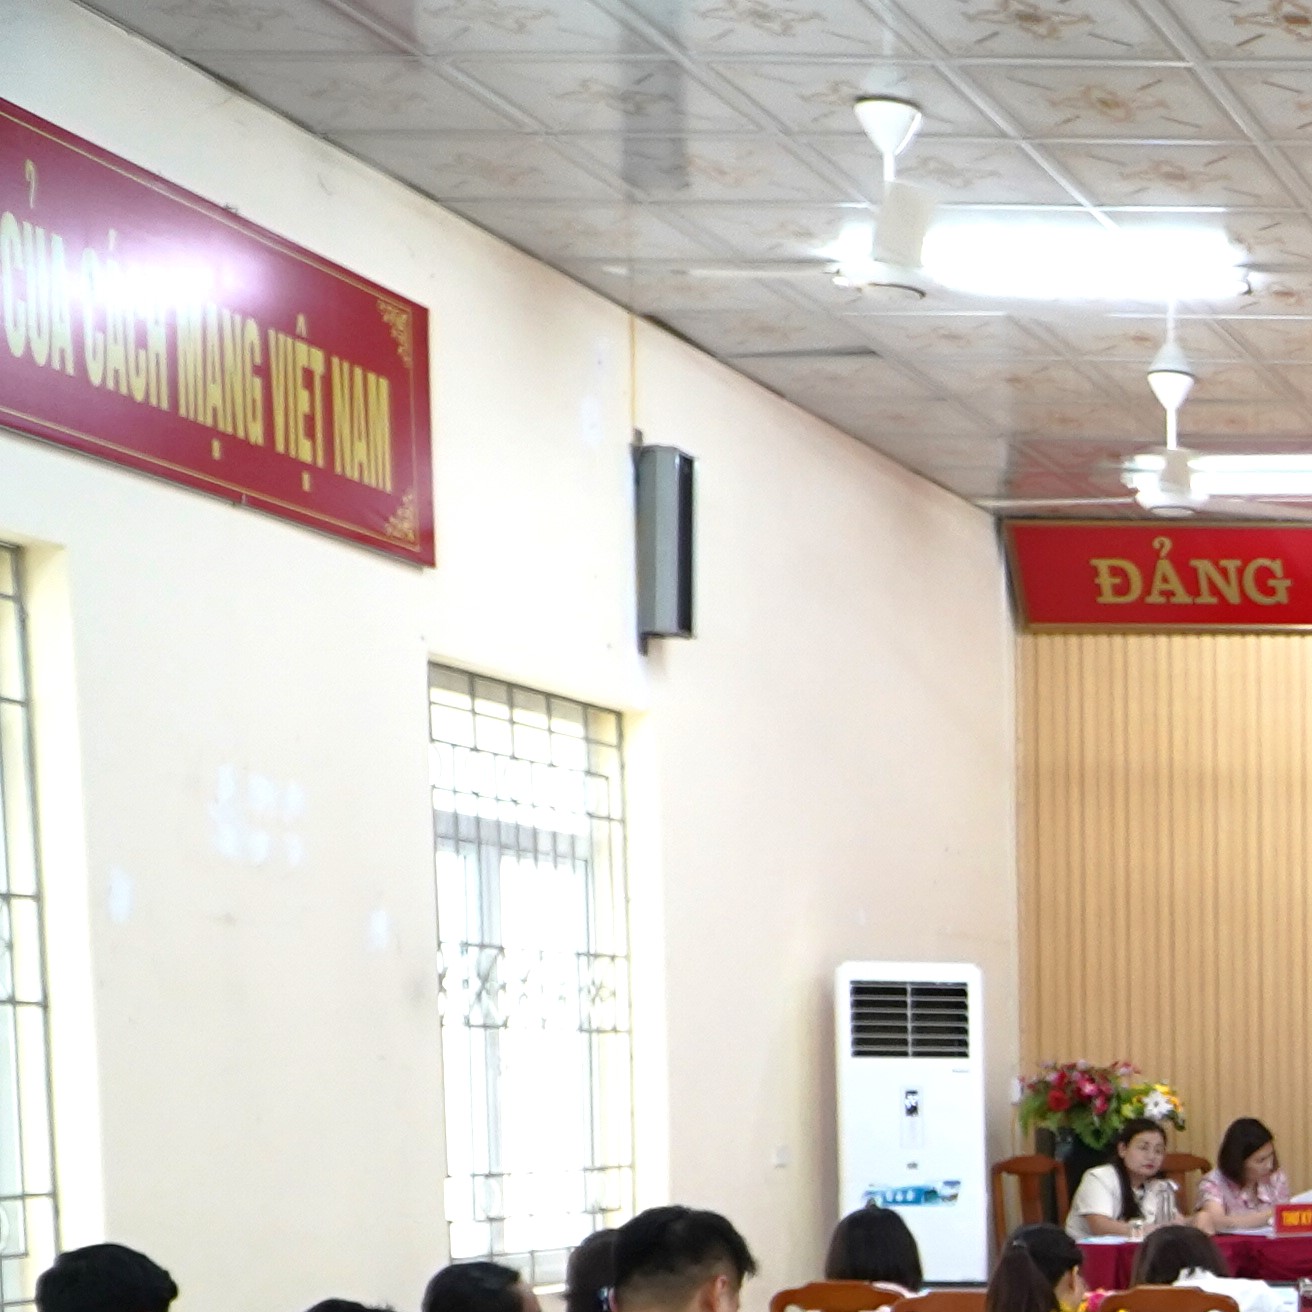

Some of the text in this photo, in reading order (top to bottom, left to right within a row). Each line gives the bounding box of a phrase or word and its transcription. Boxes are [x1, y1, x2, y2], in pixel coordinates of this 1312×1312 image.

[174, 294, 264, 461] MẠNG
[267, 313, 325, 492] VIỆT
[331, 355, 392, 494] NAM
[1090, 537, 1293, 606] ĐẢNG
